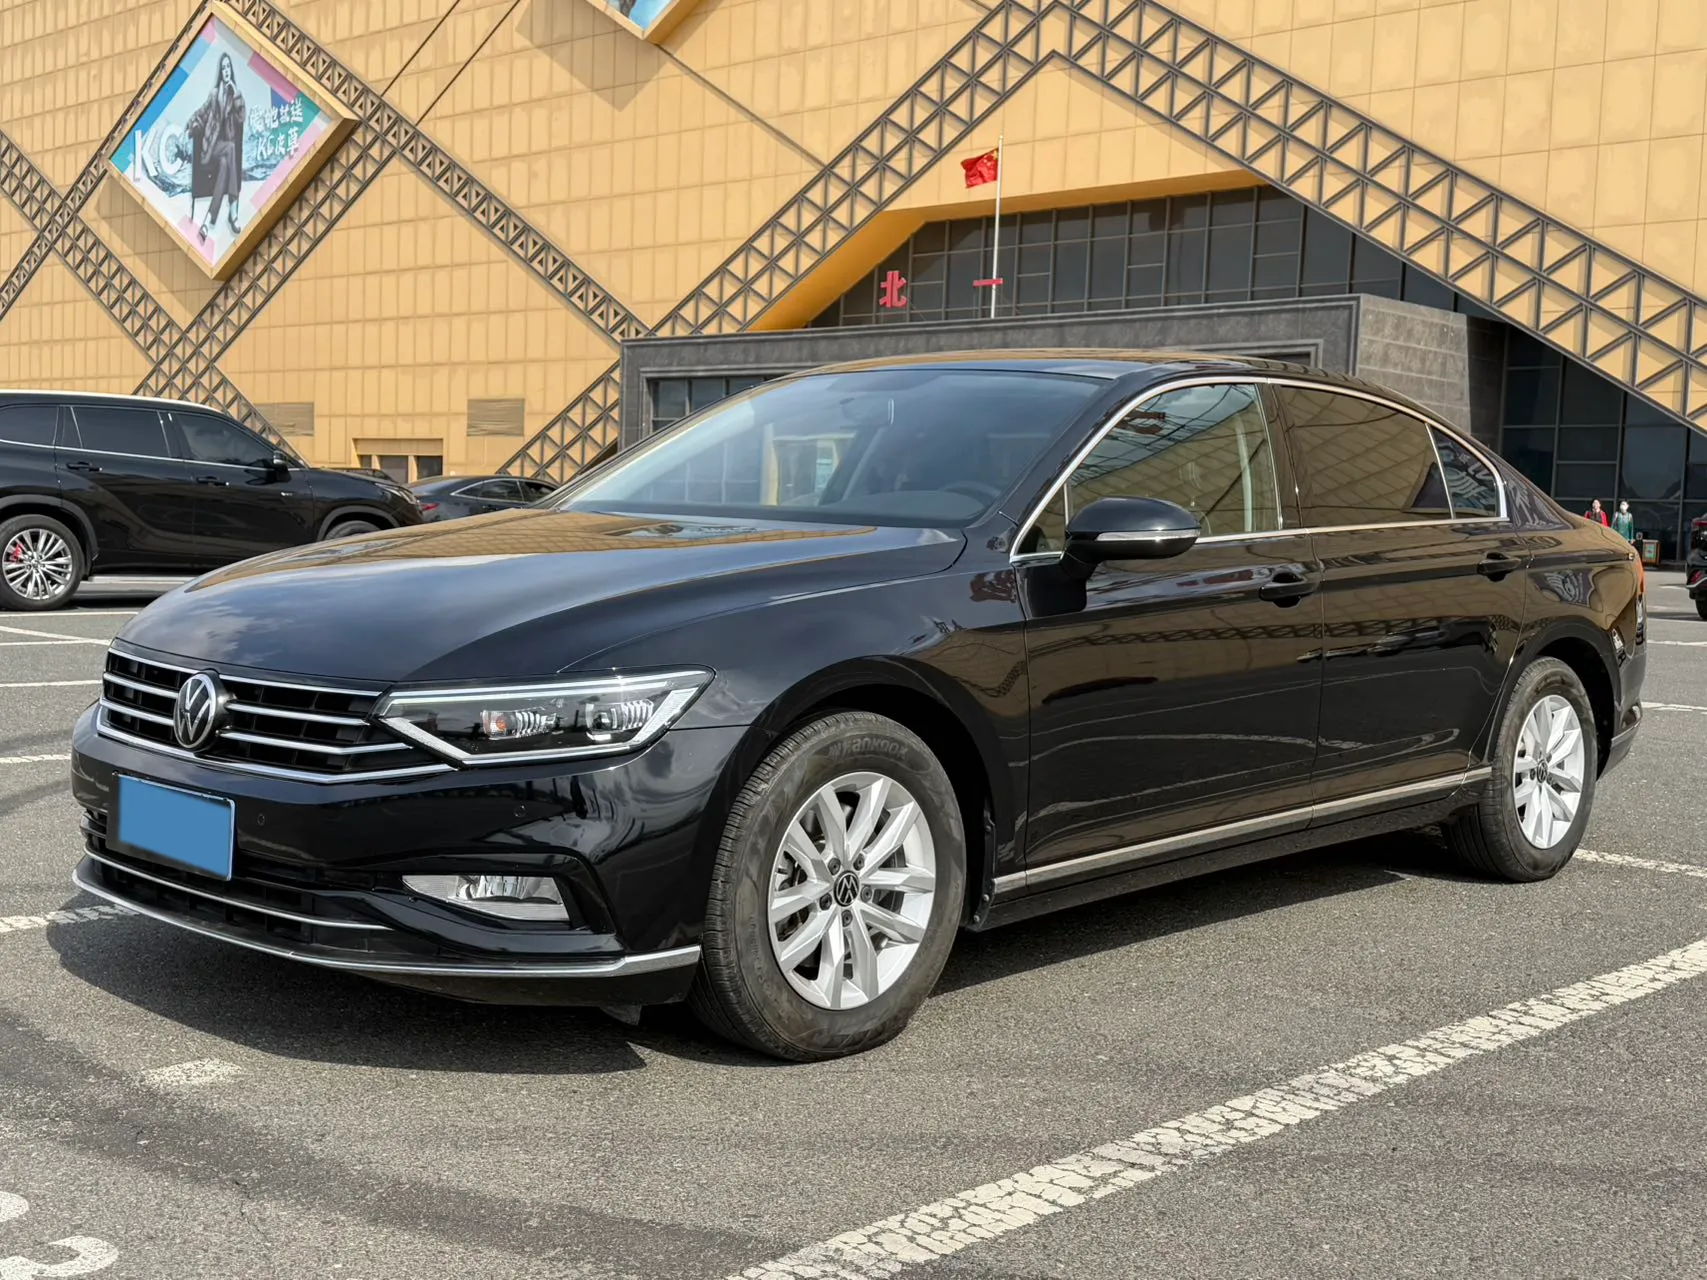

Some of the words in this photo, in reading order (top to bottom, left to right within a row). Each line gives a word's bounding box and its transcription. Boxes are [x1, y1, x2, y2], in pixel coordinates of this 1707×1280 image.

[134, 124, 183, 180] KC
[258, 126, 300, 160] KC皮草
[880, 271, 907, 308] 北
